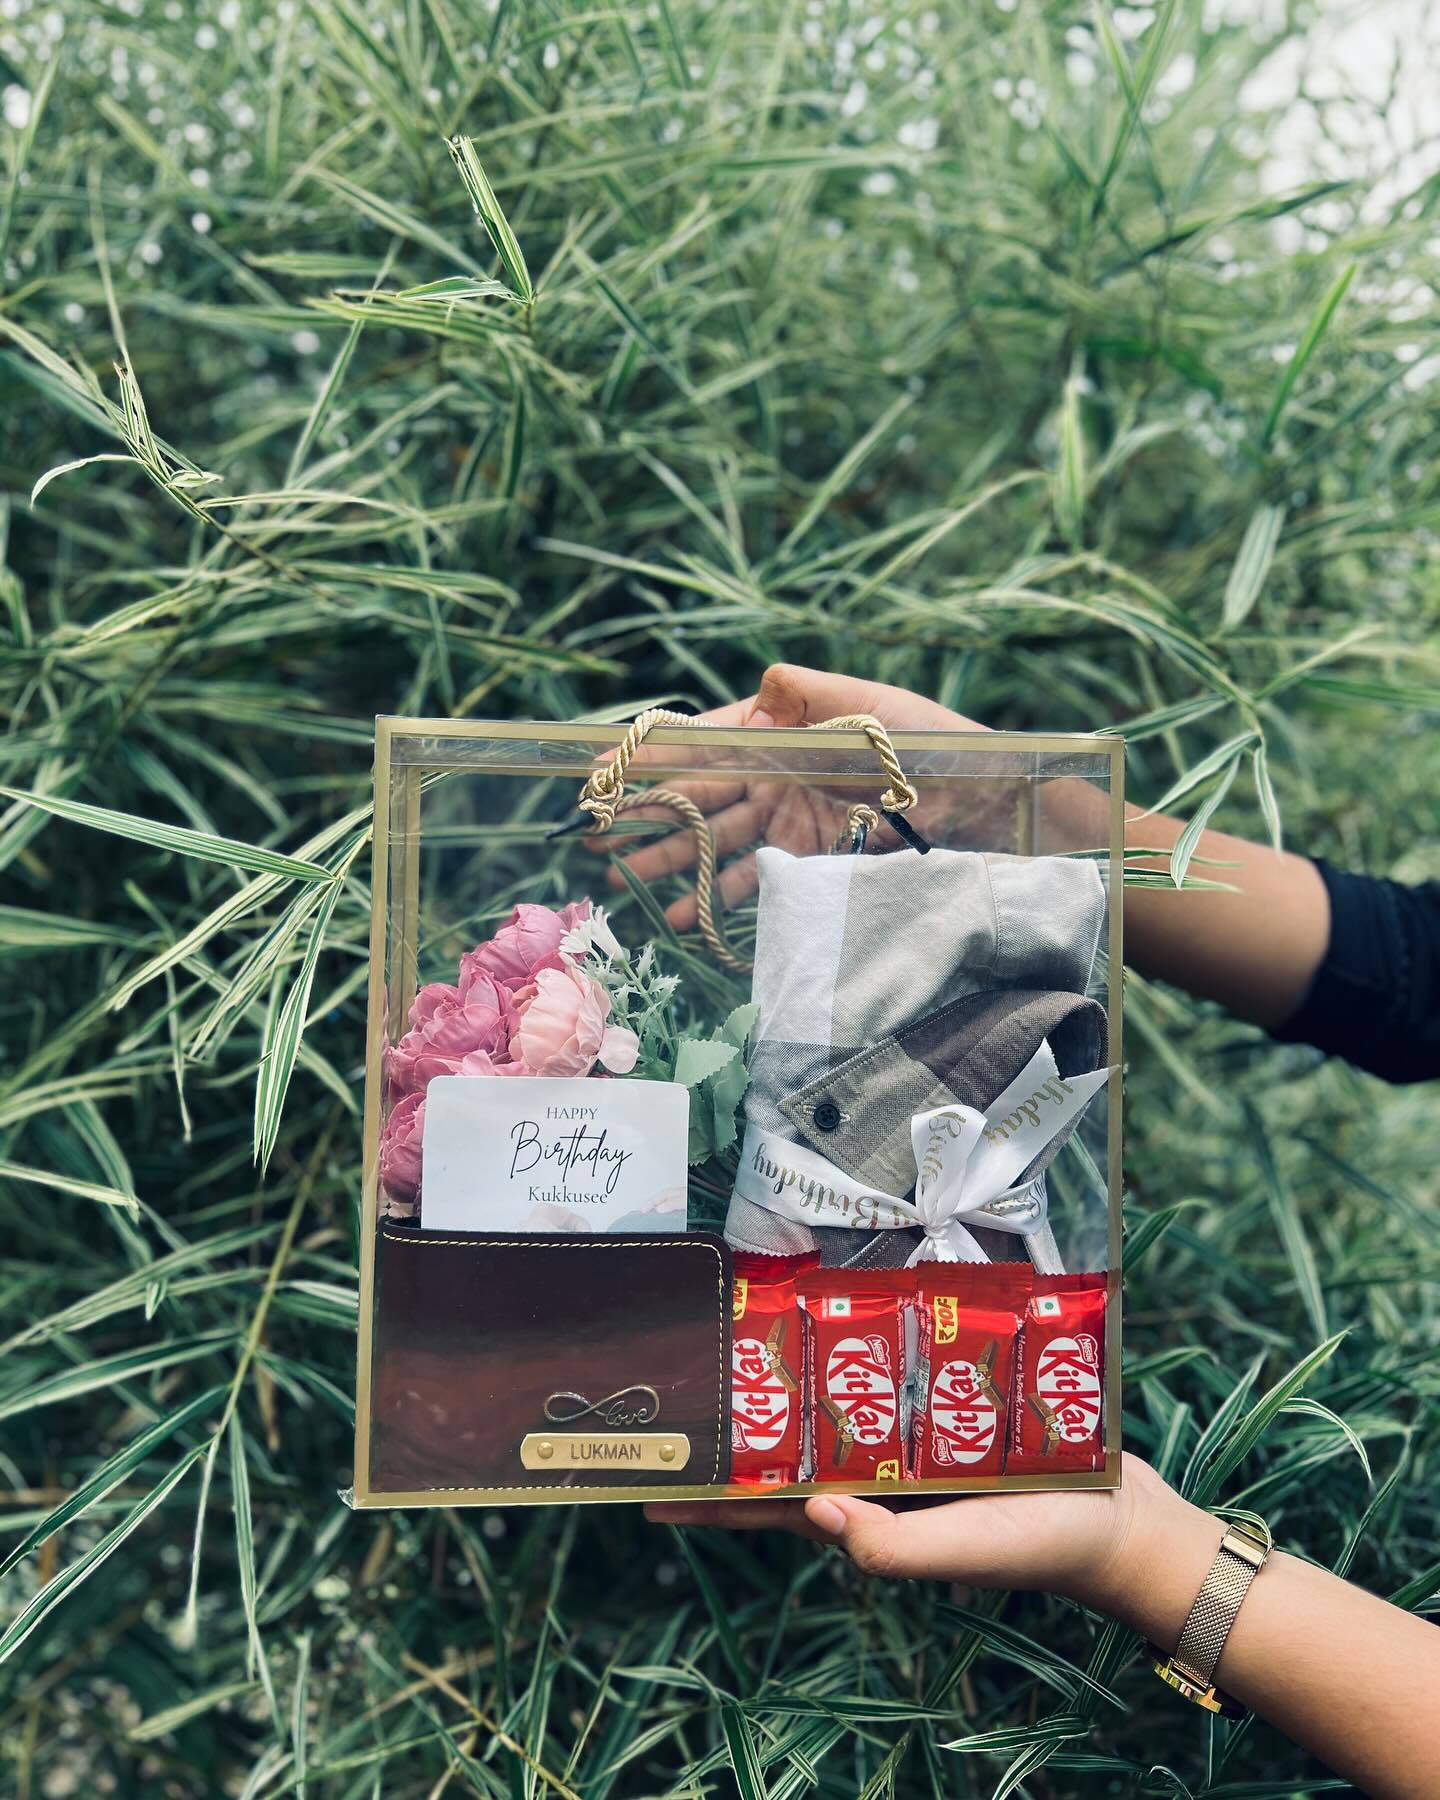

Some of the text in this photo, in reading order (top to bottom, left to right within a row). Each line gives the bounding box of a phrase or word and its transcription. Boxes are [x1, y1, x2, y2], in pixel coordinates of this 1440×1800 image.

[546, 1107, 598, 1119] HAPPY
[510, 1120, 633, 1194] Birthday
[528, 1184, 608, 1204] Kukkusee
[752, 1143, 880, 1229] Birthday
[1017, 1335, 1026, 1362] Have
[570, 1443, 642, 1460] LUKMAN
